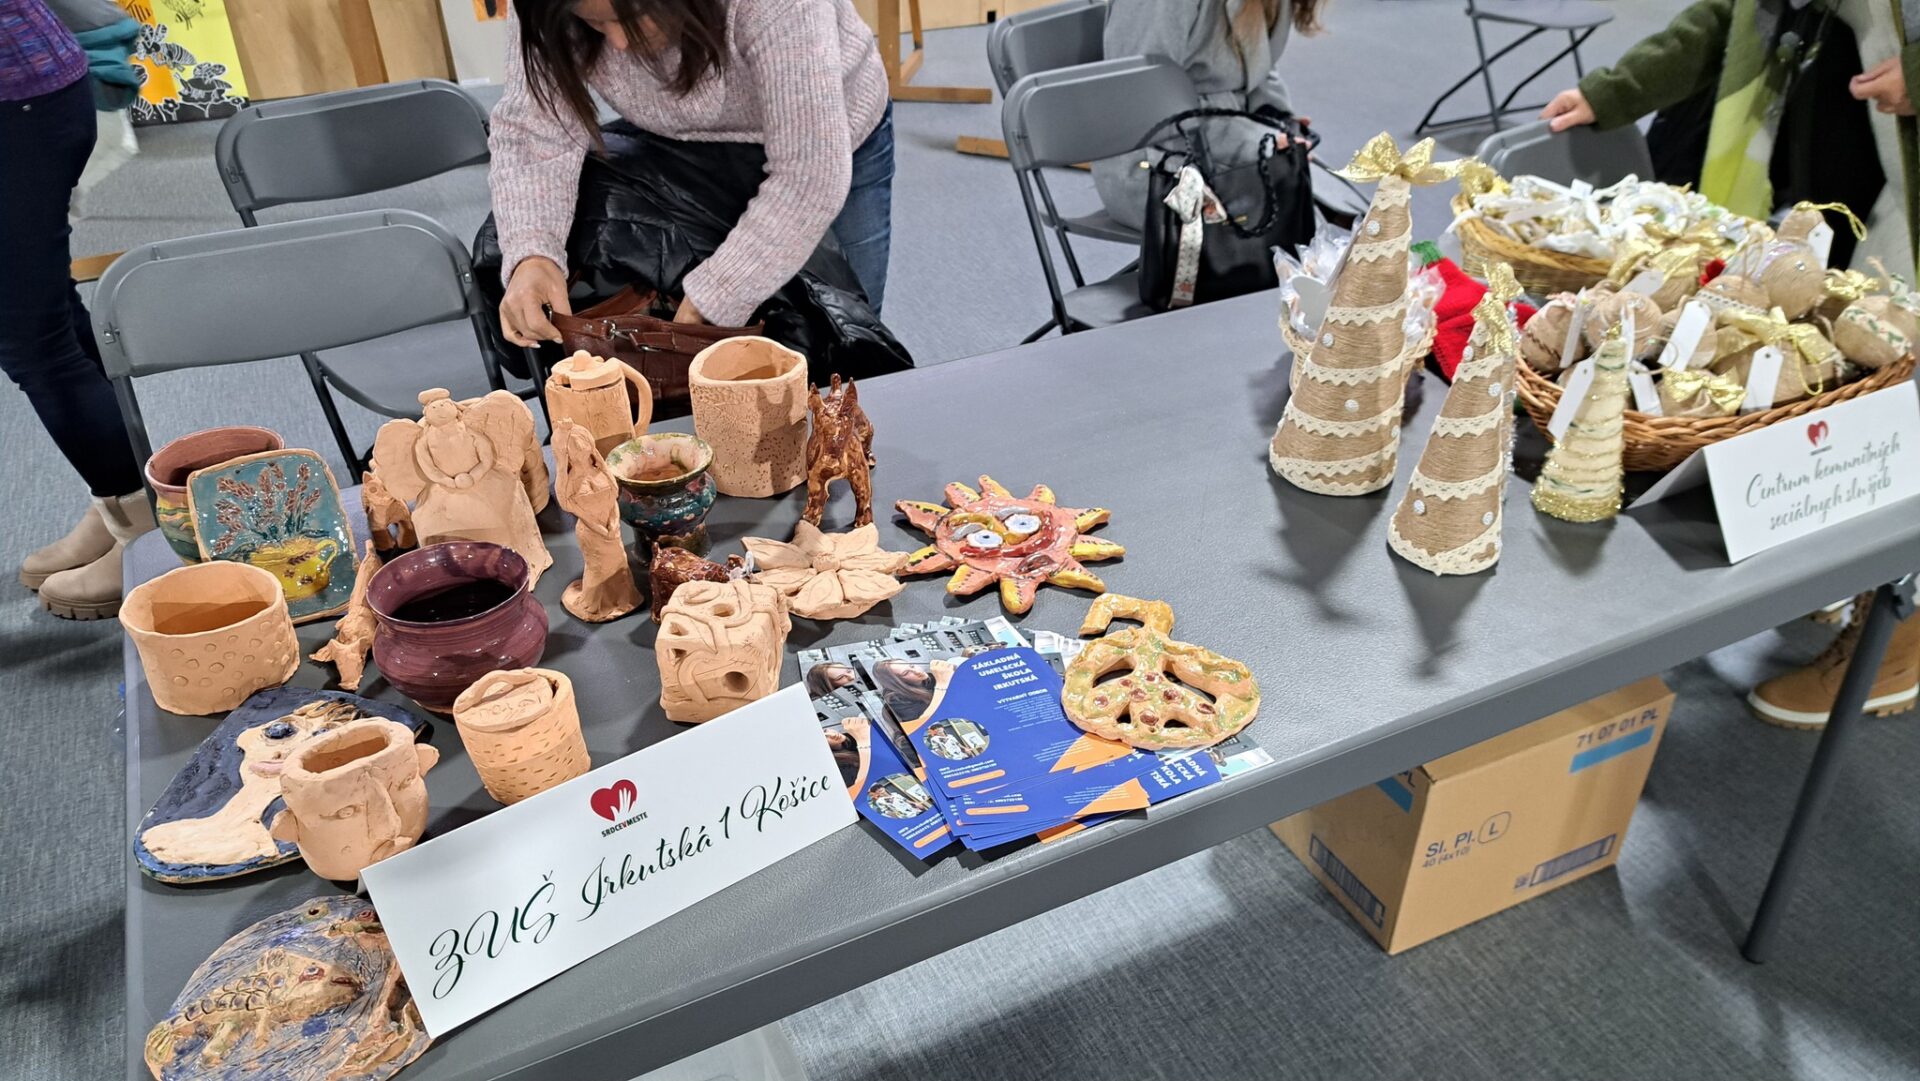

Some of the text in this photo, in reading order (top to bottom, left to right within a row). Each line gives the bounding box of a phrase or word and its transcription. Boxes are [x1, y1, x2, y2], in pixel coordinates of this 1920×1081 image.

[1746, 473, 1810, 508] Centrum
[971, 652, 1021, 670] ZÁKLADNÁ
[978, 660, 1027, 677] UMELECKÁ
[992, 673, 1039, 691] IRKUTSKÁ
[1001, 667, 1033, 680] ŠKOLA
[1577, 708, 1658, 748] 71 07 01 PL
[1160, 765, 1182, 785] KOLA
[1185, 755, 1208, 777] ADNÁ
[1150, 770, 1172, 789] TSKÁ
[601, 811, 648, 838] SRDCEVMESTE
[577, 824, 714, 923] Irkutská
[718, 805, 731, 840] 1
[739, 771, 832, 833] Košice
